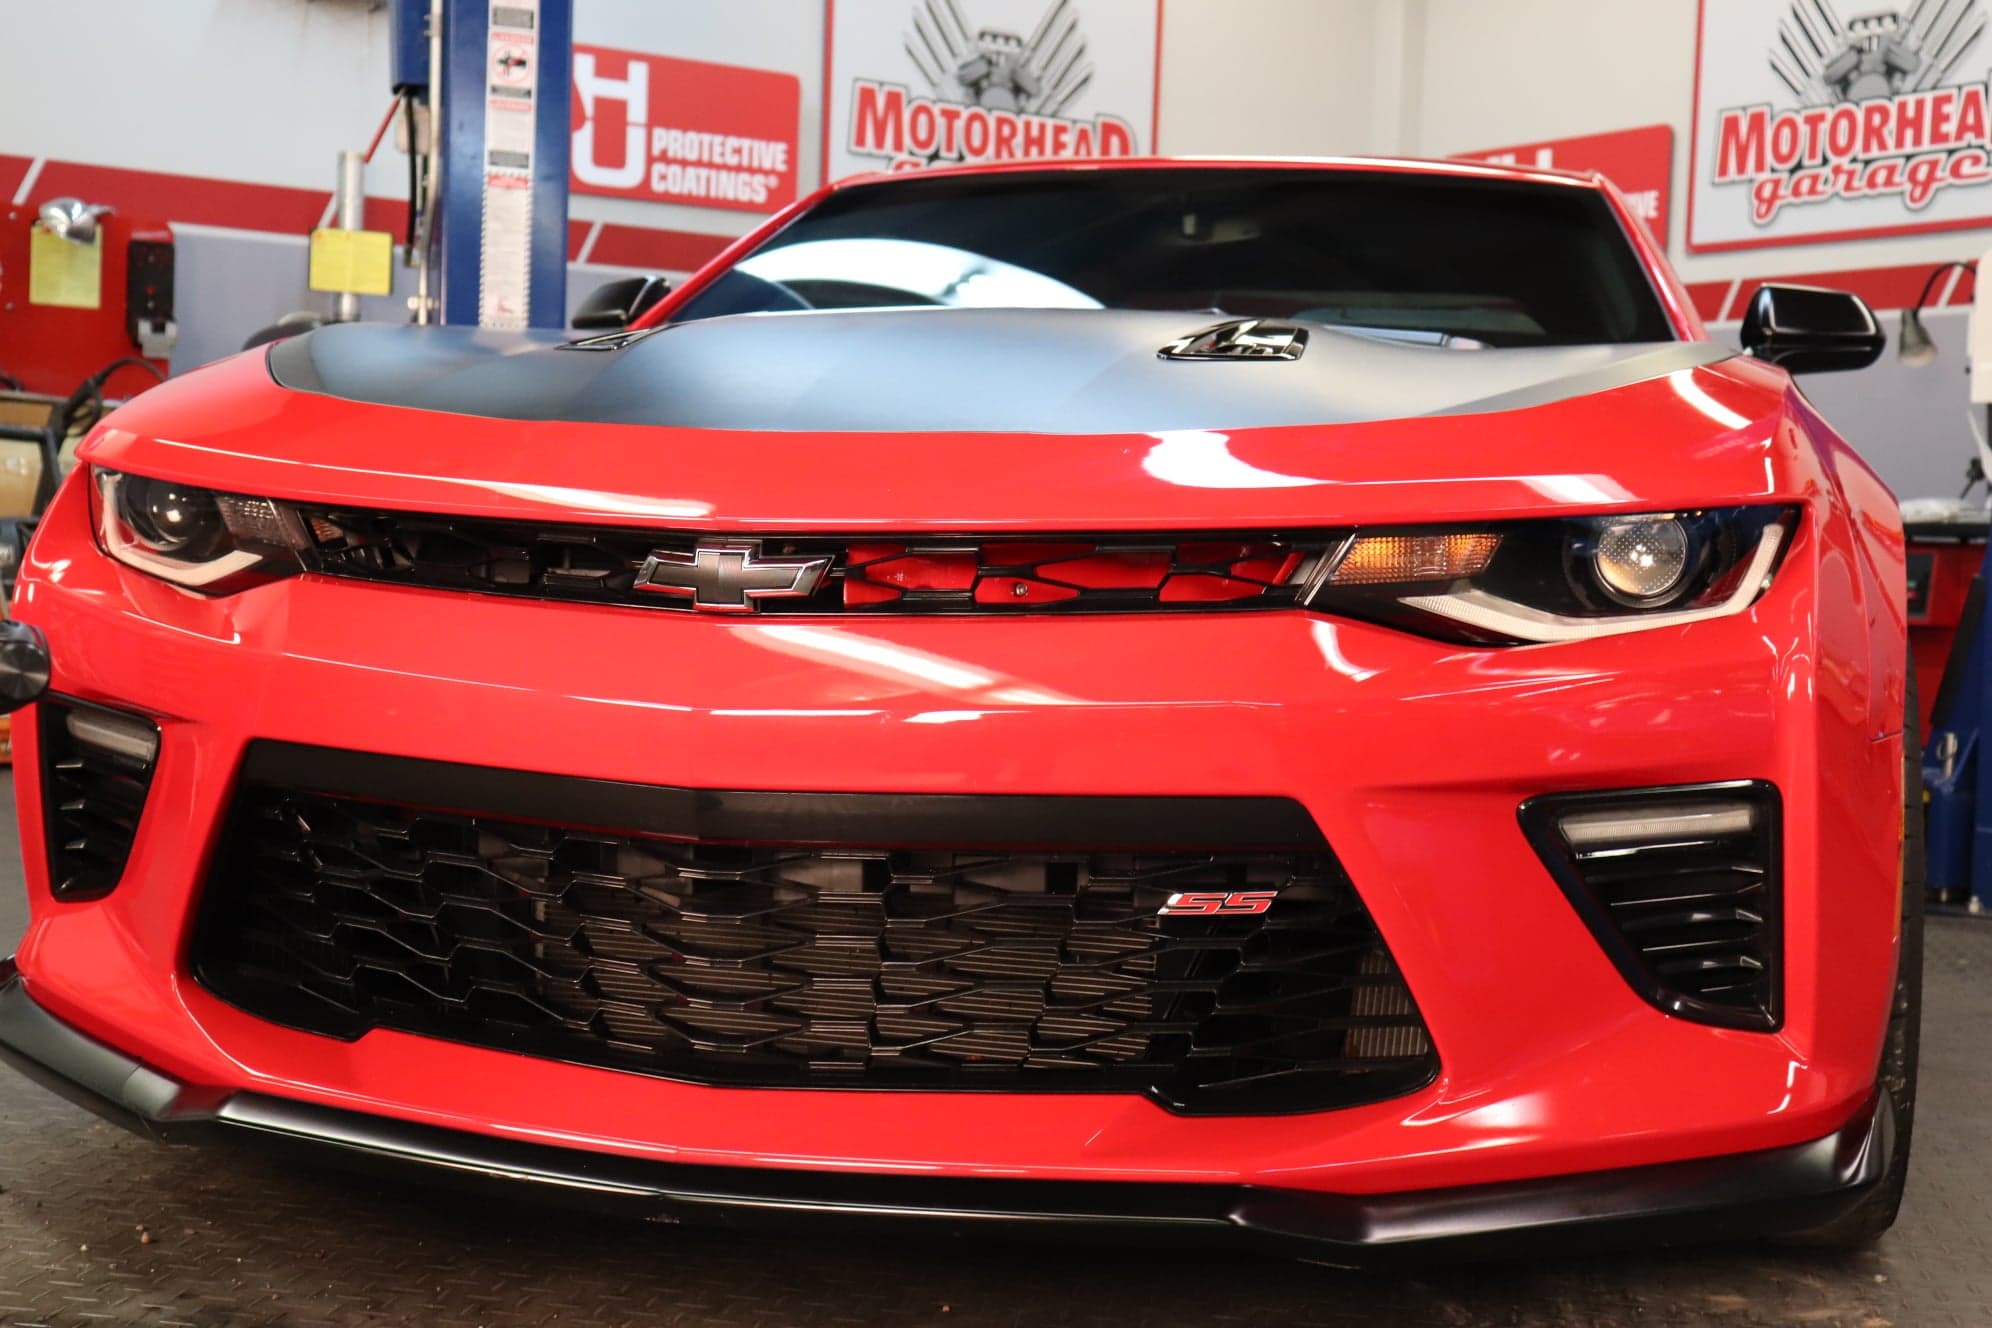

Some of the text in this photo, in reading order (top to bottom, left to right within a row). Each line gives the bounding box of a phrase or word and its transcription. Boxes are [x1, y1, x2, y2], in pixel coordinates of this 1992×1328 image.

[651, 126, 788, 172] PROTECTIVE
[852, 83, 1133, 160] MOTORHEAD
[1715, 88, 1992, 179] MOTORHEA
[1753, 151, 1992, 220] garage
[1157, 890, 1278, 915] SS
